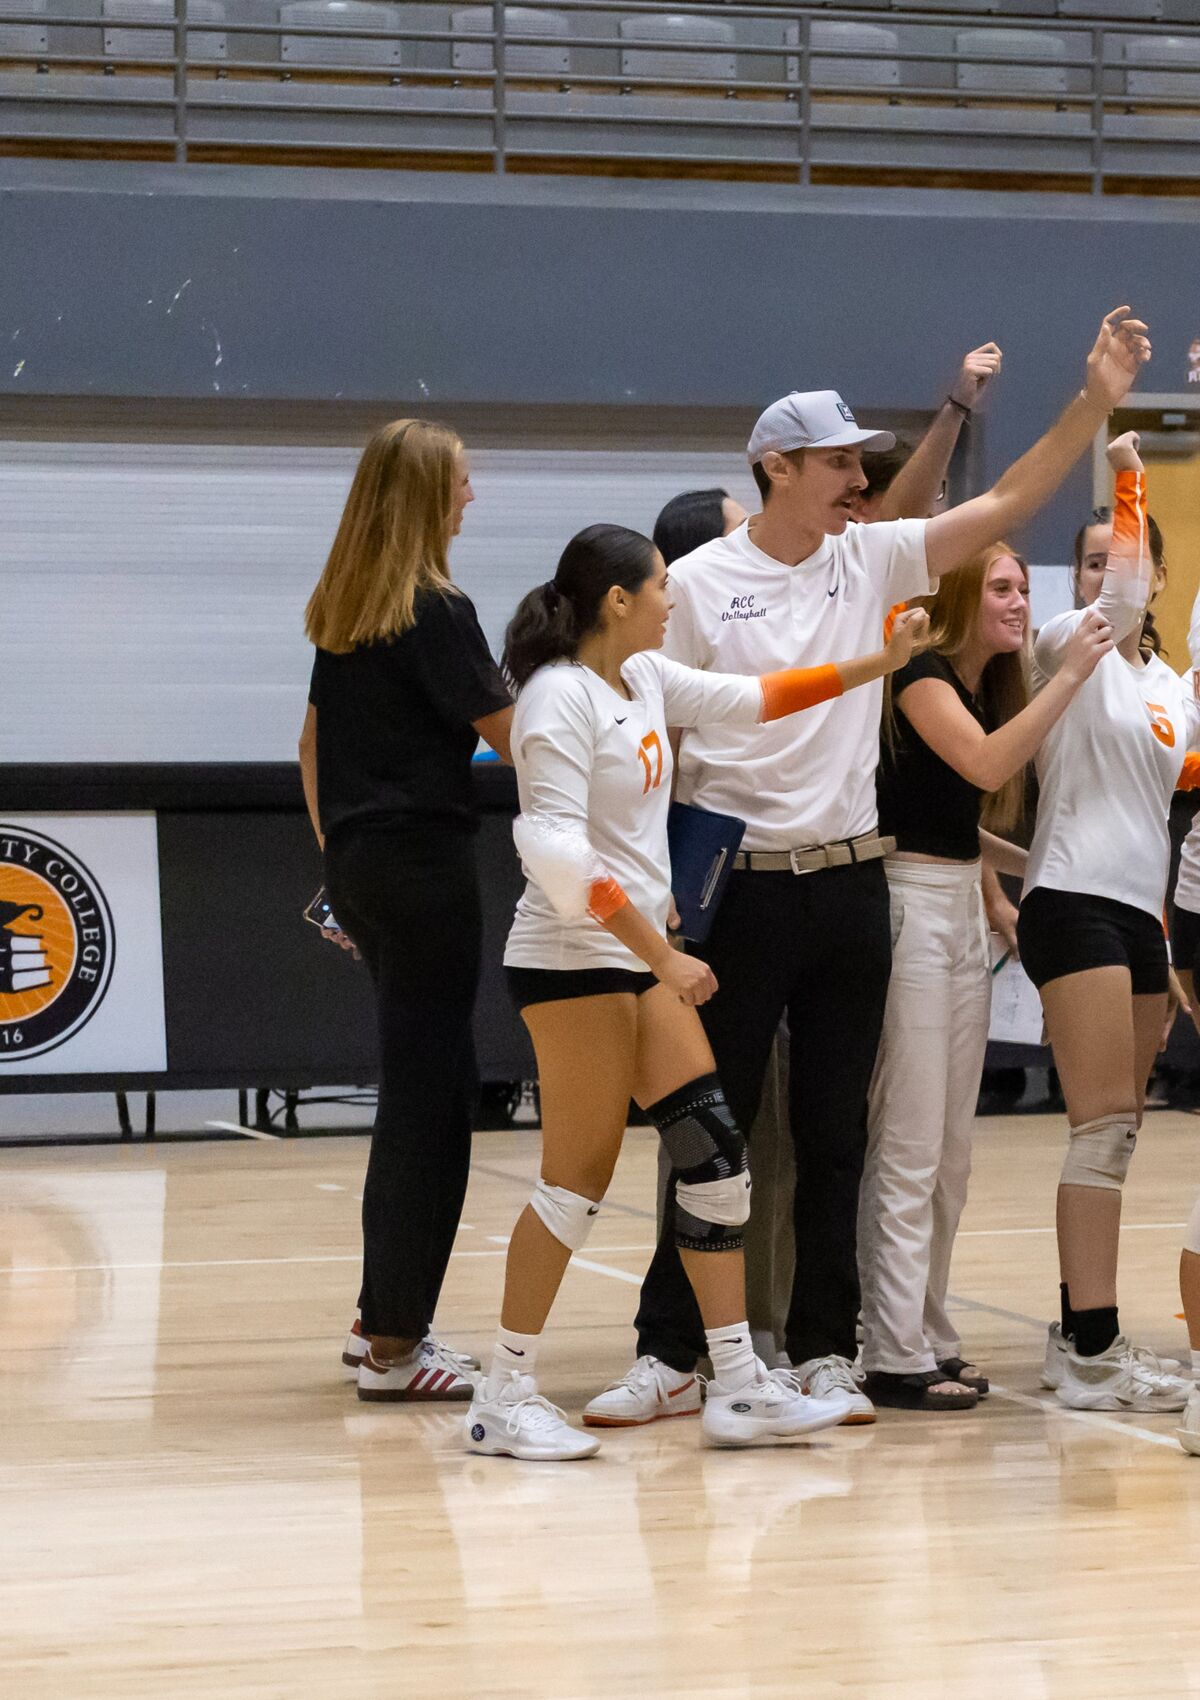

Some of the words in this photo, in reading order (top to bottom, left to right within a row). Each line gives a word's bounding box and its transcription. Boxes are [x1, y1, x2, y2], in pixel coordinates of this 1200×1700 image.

[721, 607, 767, 622] Volleyball
[730, 595, 755, 609] RCC
[1144, 702, 1175, 749] 5
[637, 729, 663, 795] 17
[45, 859, 101, 983] COLLEGE
